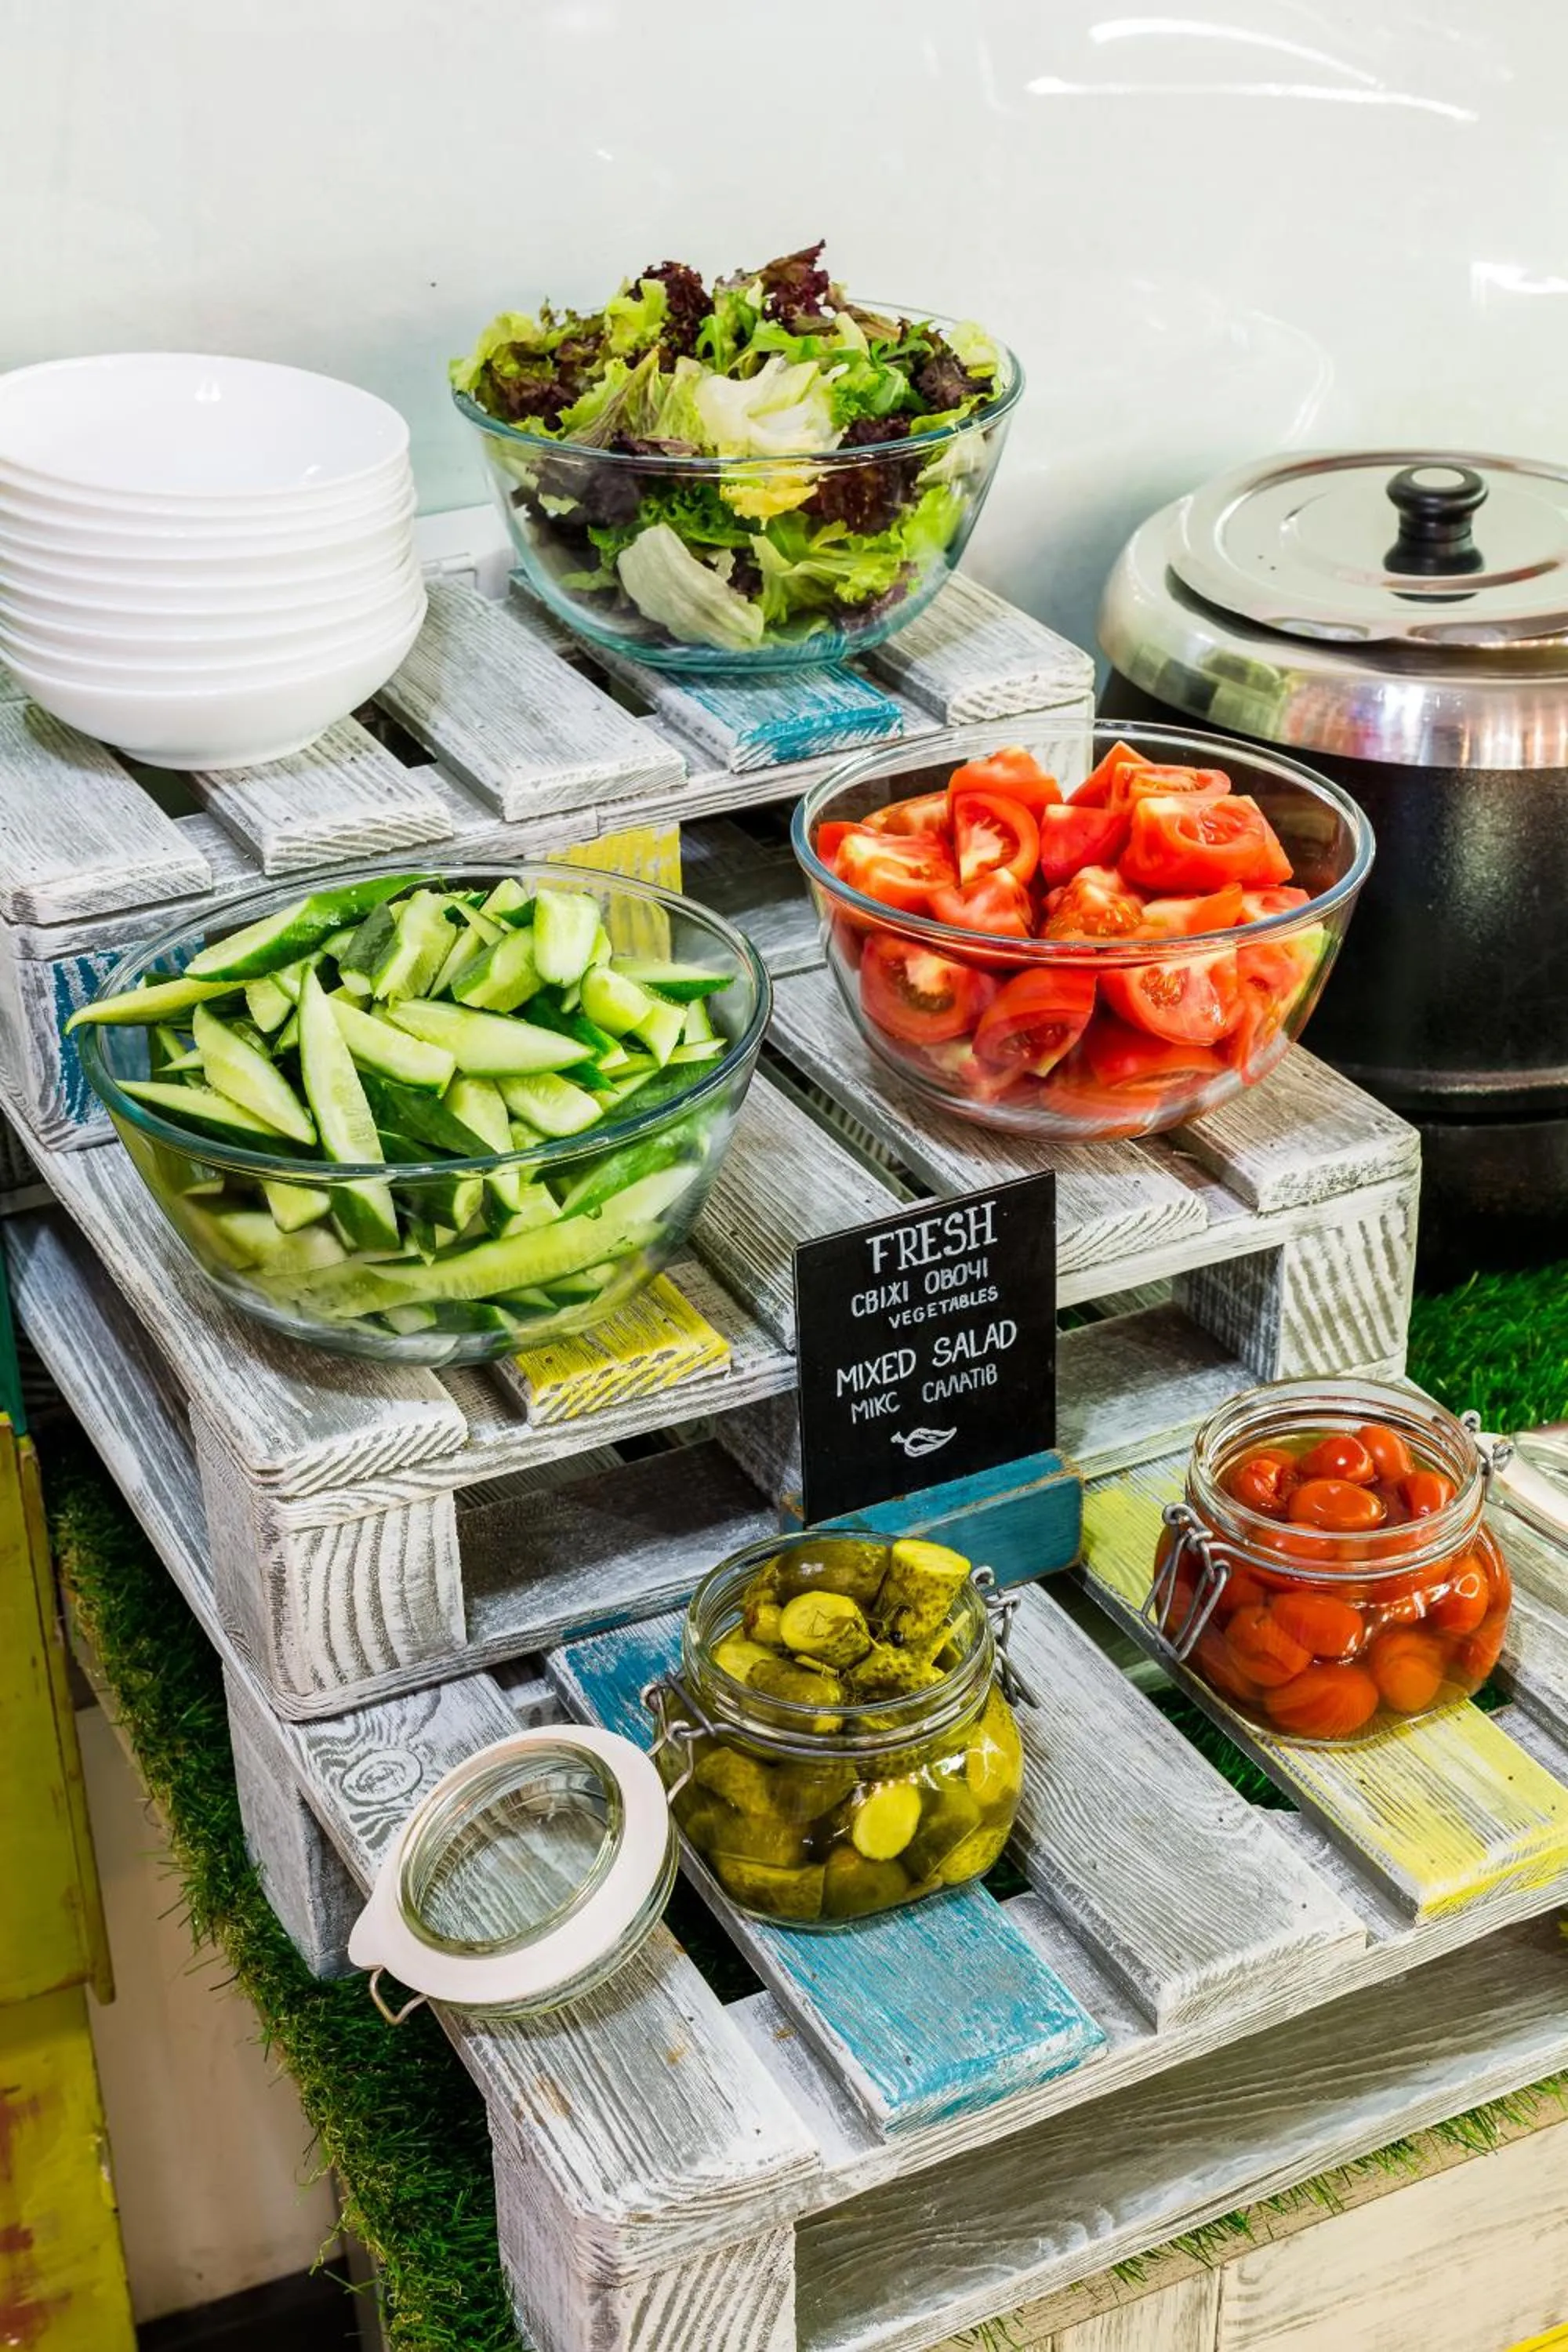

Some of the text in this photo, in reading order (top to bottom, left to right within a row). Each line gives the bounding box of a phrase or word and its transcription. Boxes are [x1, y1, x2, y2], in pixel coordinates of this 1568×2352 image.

[866, 1201, 997, 1273] FRESH
[851, 1258, 988, 1317] СВІЖІ ОВОЧІ
[889, 1286, 999, 1328] VEGETABLES
[837, 1320, 1018, 1397] MIXED SALAD
[851, 1364, 997, 1424] МІКС САЛАТІВ
